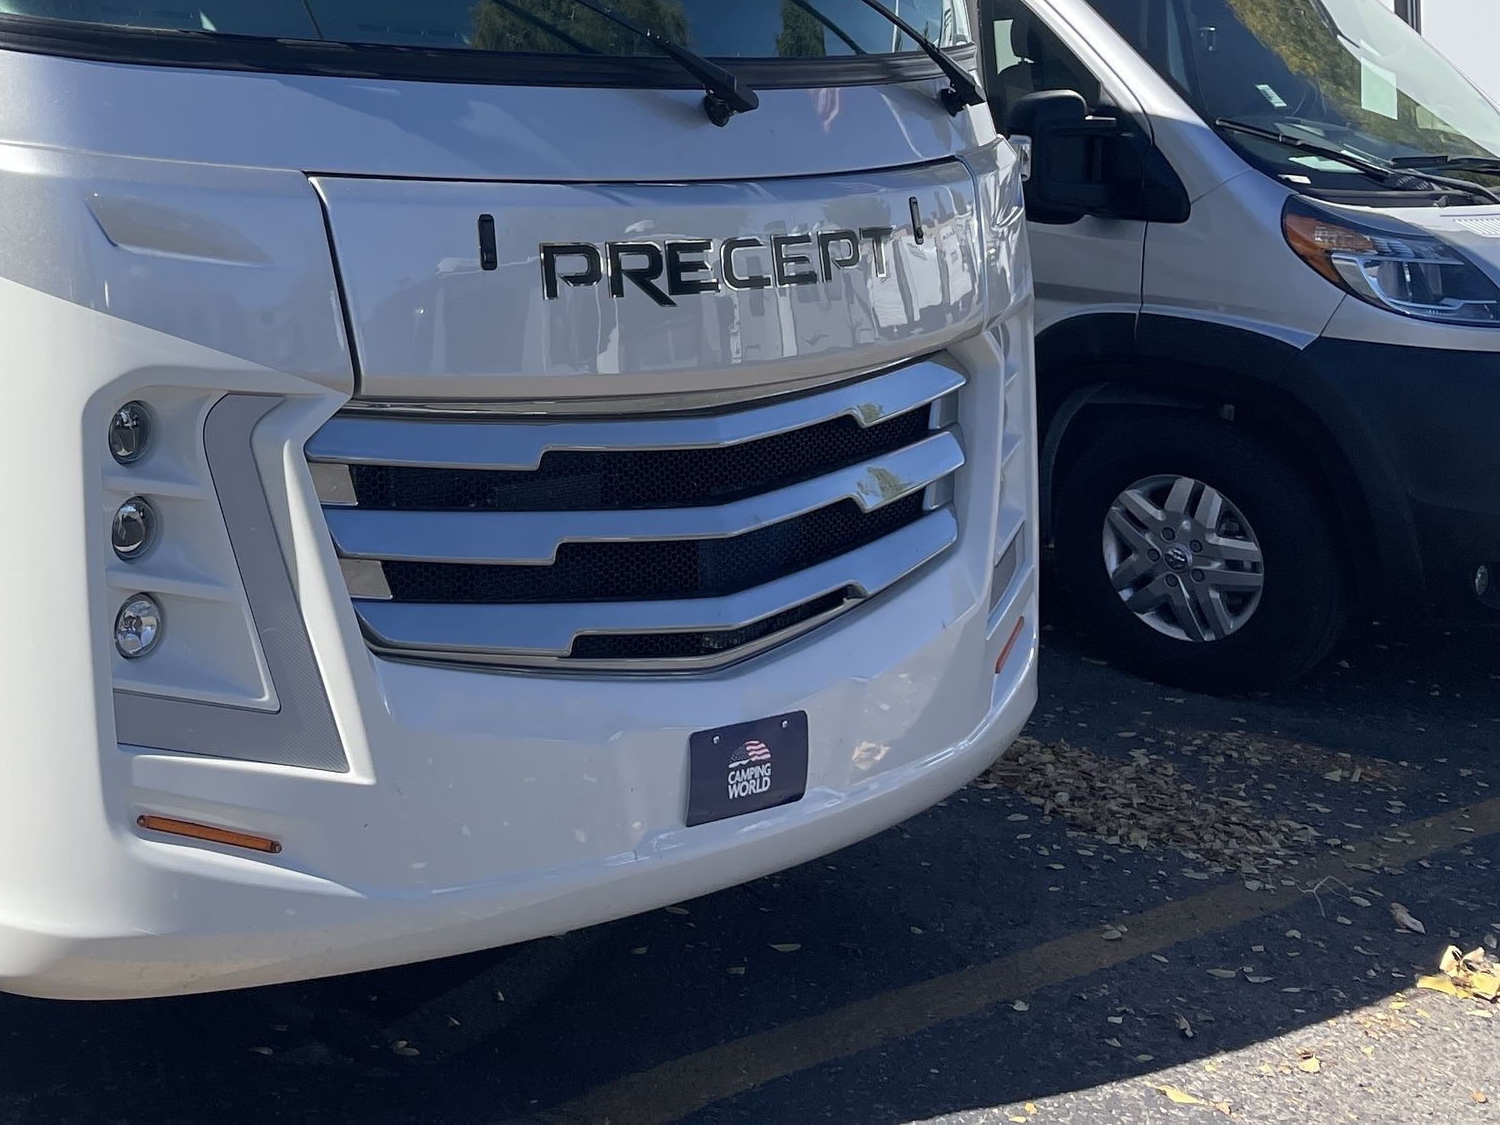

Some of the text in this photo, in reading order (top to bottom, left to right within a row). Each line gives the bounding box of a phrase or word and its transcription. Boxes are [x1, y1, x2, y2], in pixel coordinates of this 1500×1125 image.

[539, 226, 896, 307] PRECEPT
[728, 763, 771, 784] CAMPING
[728, 777, 771, 800] WORLD
